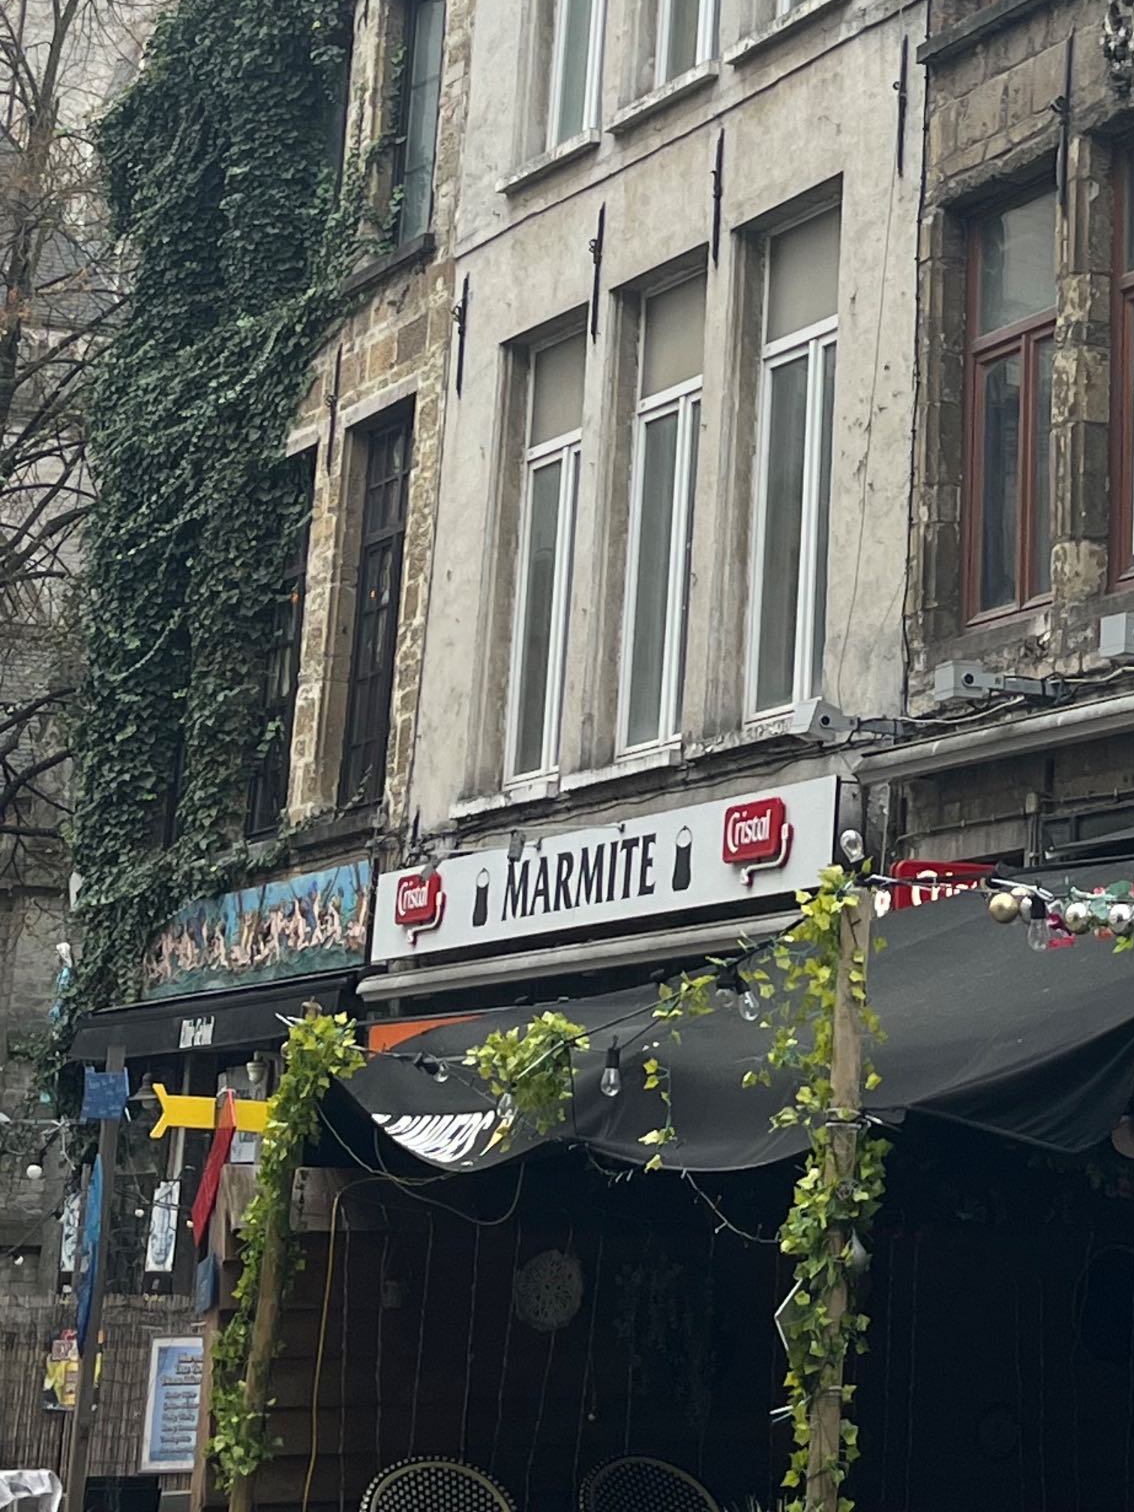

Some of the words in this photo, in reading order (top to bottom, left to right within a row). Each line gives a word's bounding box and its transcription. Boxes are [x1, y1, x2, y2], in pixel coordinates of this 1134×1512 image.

[727, 808, 771, 854] Cristal
[398, 881, 429, 916] Cristal
[501, 833, 656, 922] MARMITE
